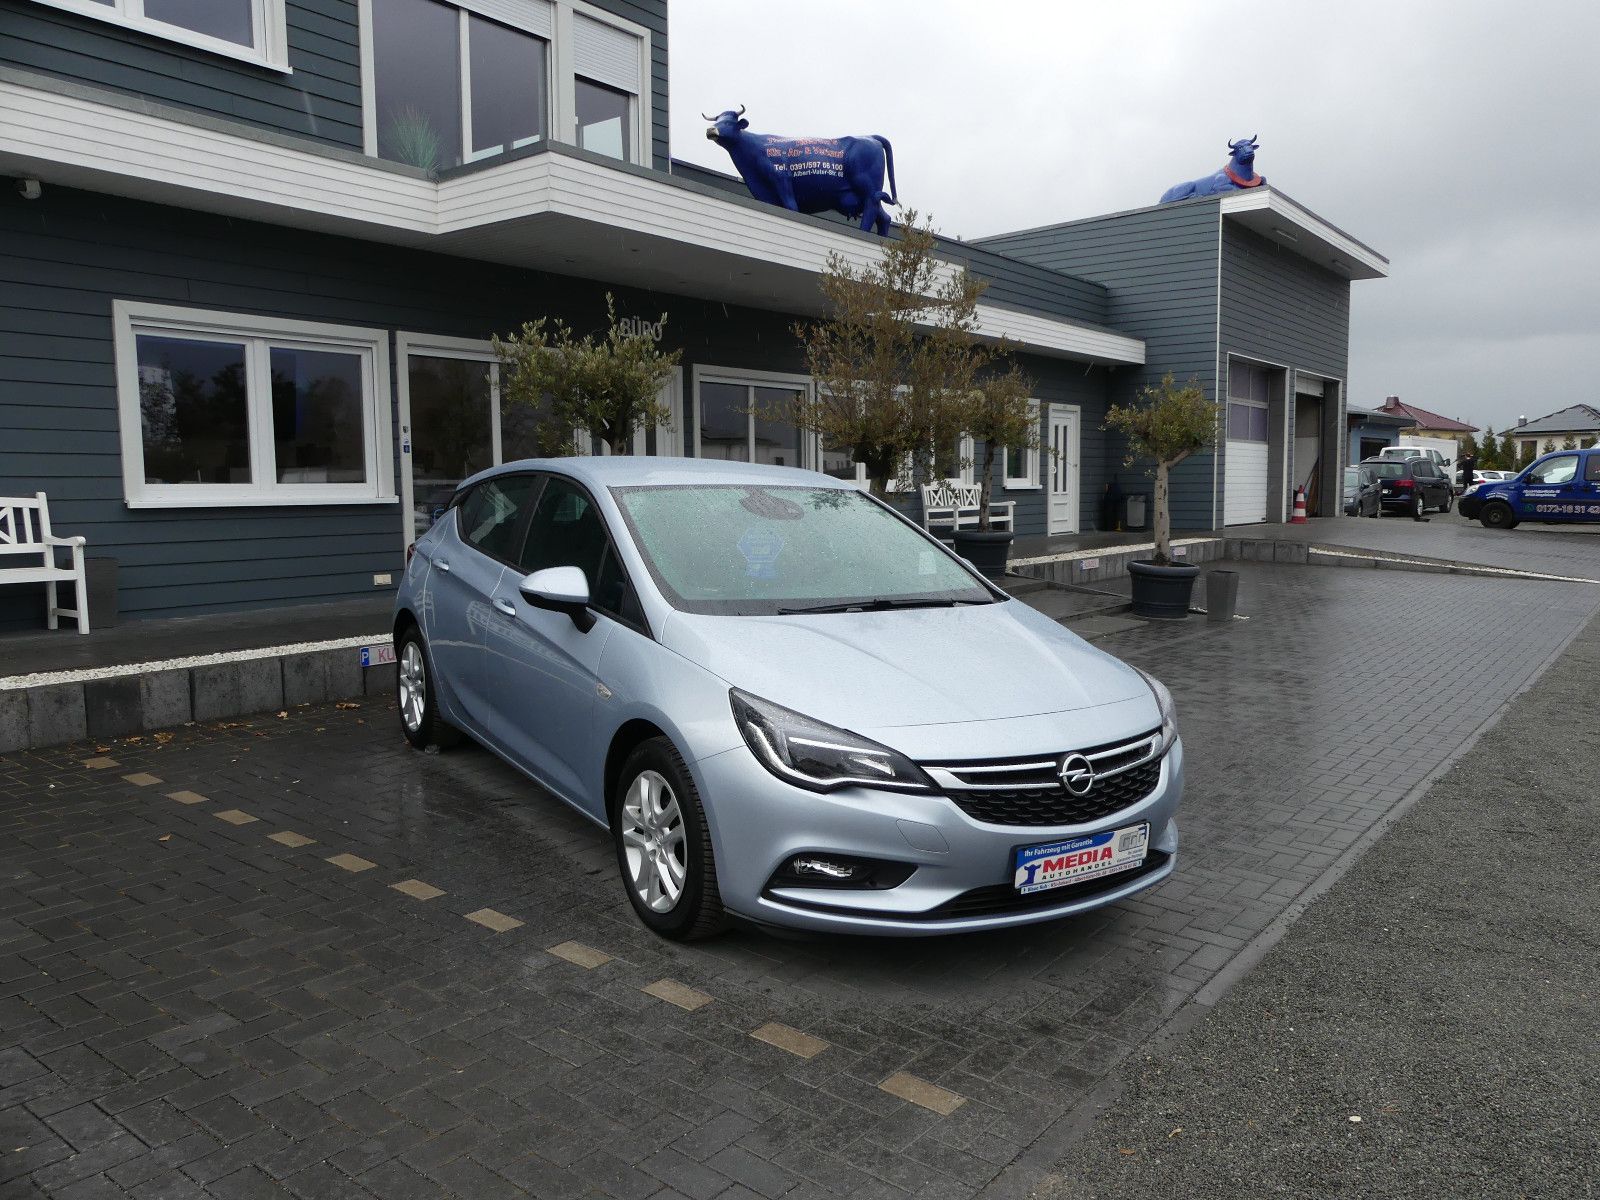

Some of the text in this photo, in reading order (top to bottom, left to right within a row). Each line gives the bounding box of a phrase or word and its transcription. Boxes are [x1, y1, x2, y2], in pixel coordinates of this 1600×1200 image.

[790, 162, 821, 171] 0391/597
[620, 315, 662, 341] BÜRO
[362, 652, 369, 662] P
[1034, 846, 1061, 856] Fahrzeug
[1071, 839, 1093, 848] Garantie
[1043, 846, 1113, 873] MEDIA
[1041, 861, 1112, 880] AUTOHANDEL
